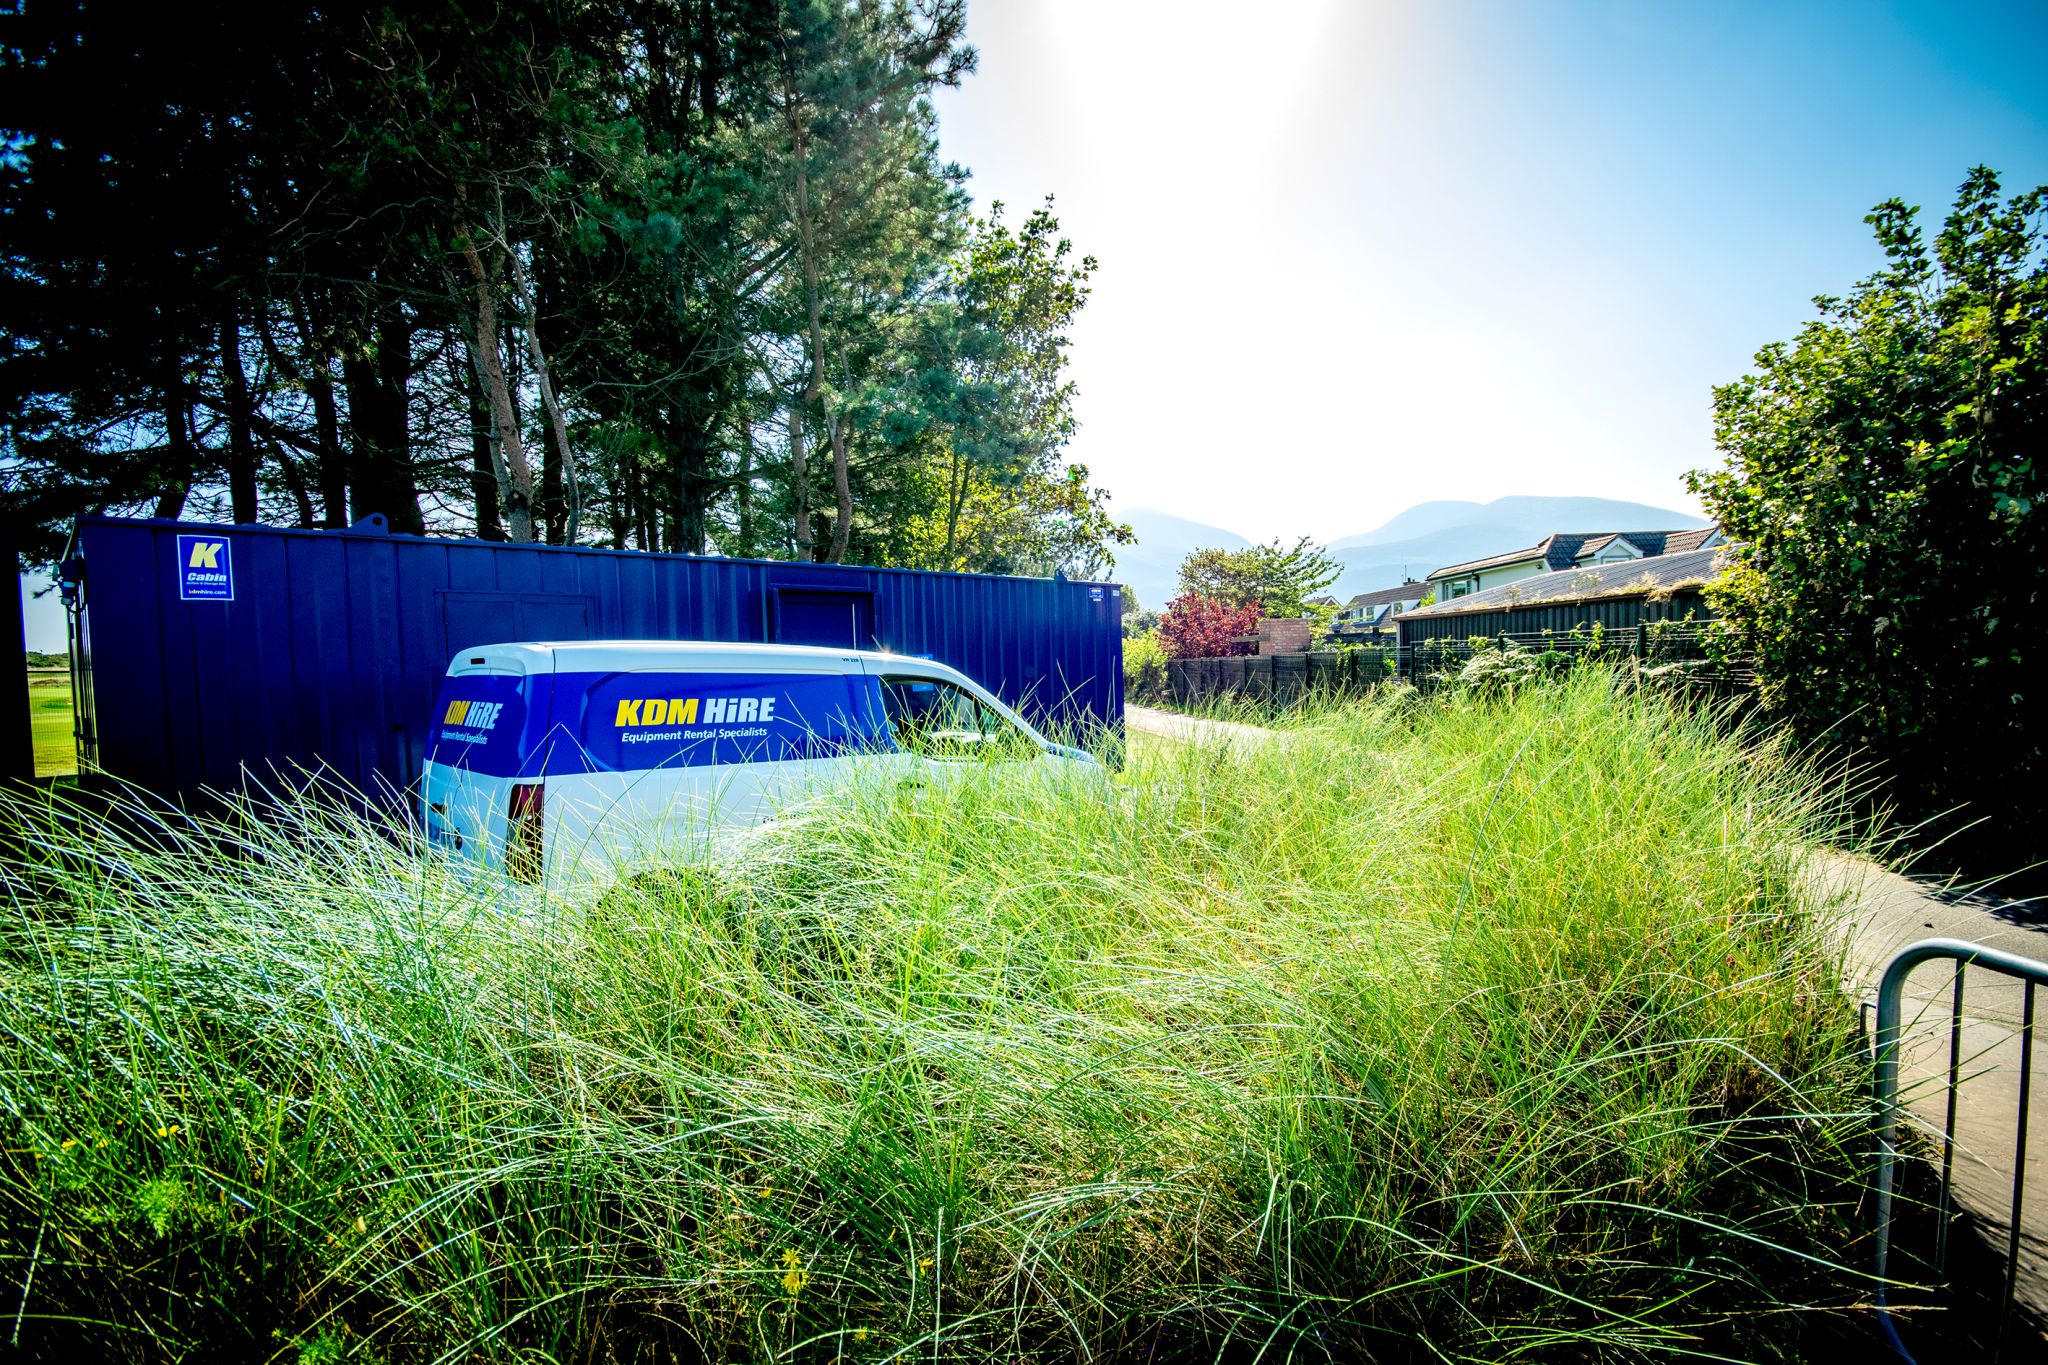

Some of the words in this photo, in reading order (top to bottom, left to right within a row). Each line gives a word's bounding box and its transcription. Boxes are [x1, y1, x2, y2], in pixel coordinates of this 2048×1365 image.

[189, 542, 223, 568] K
[187, 572, 227, 582] Cabin
[444, 700, 471, 726] KDM
[615, 699, 699, 727] KDM
[703, 697, 776, 724] HiRE
[622, 731, 682, 744] Equipment
[684, 729, 717, 739] Rental
[719, 727, 768, 739] Specialists
